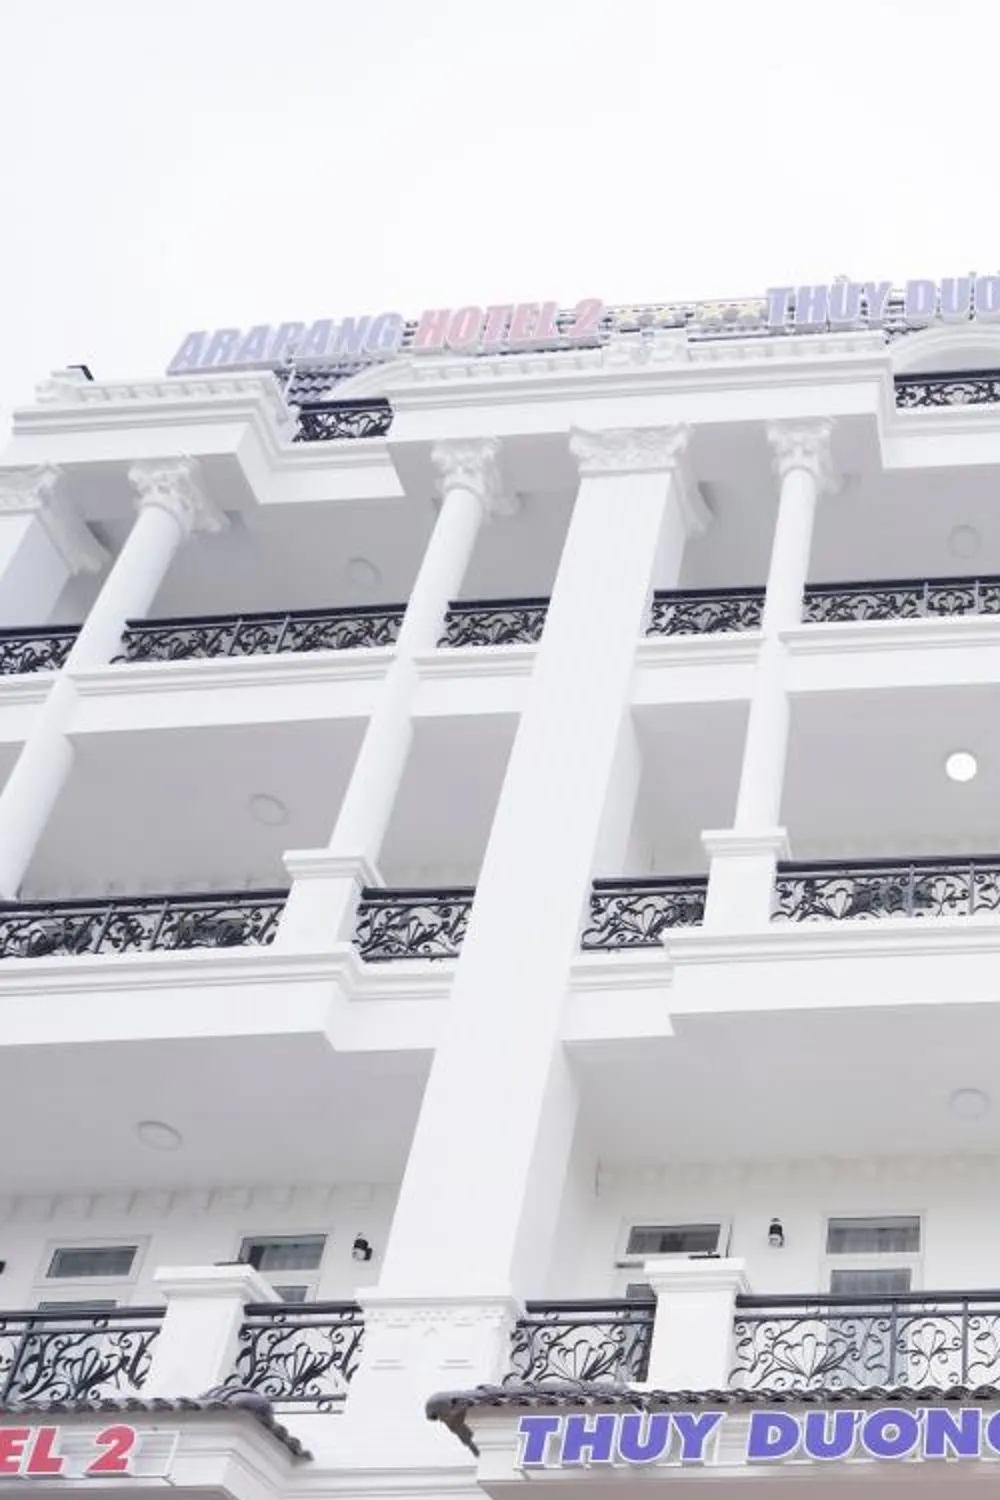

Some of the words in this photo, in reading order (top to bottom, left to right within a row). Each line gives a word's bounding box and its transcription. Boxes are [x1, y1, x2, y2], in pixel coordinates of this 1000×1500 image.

[166, 312, 402, 374] ARAPANG
[412, 301, 559, 349] HOTEL
[566, 297, 605, 339] 2
[85, 1423, 138, 1474] 2
